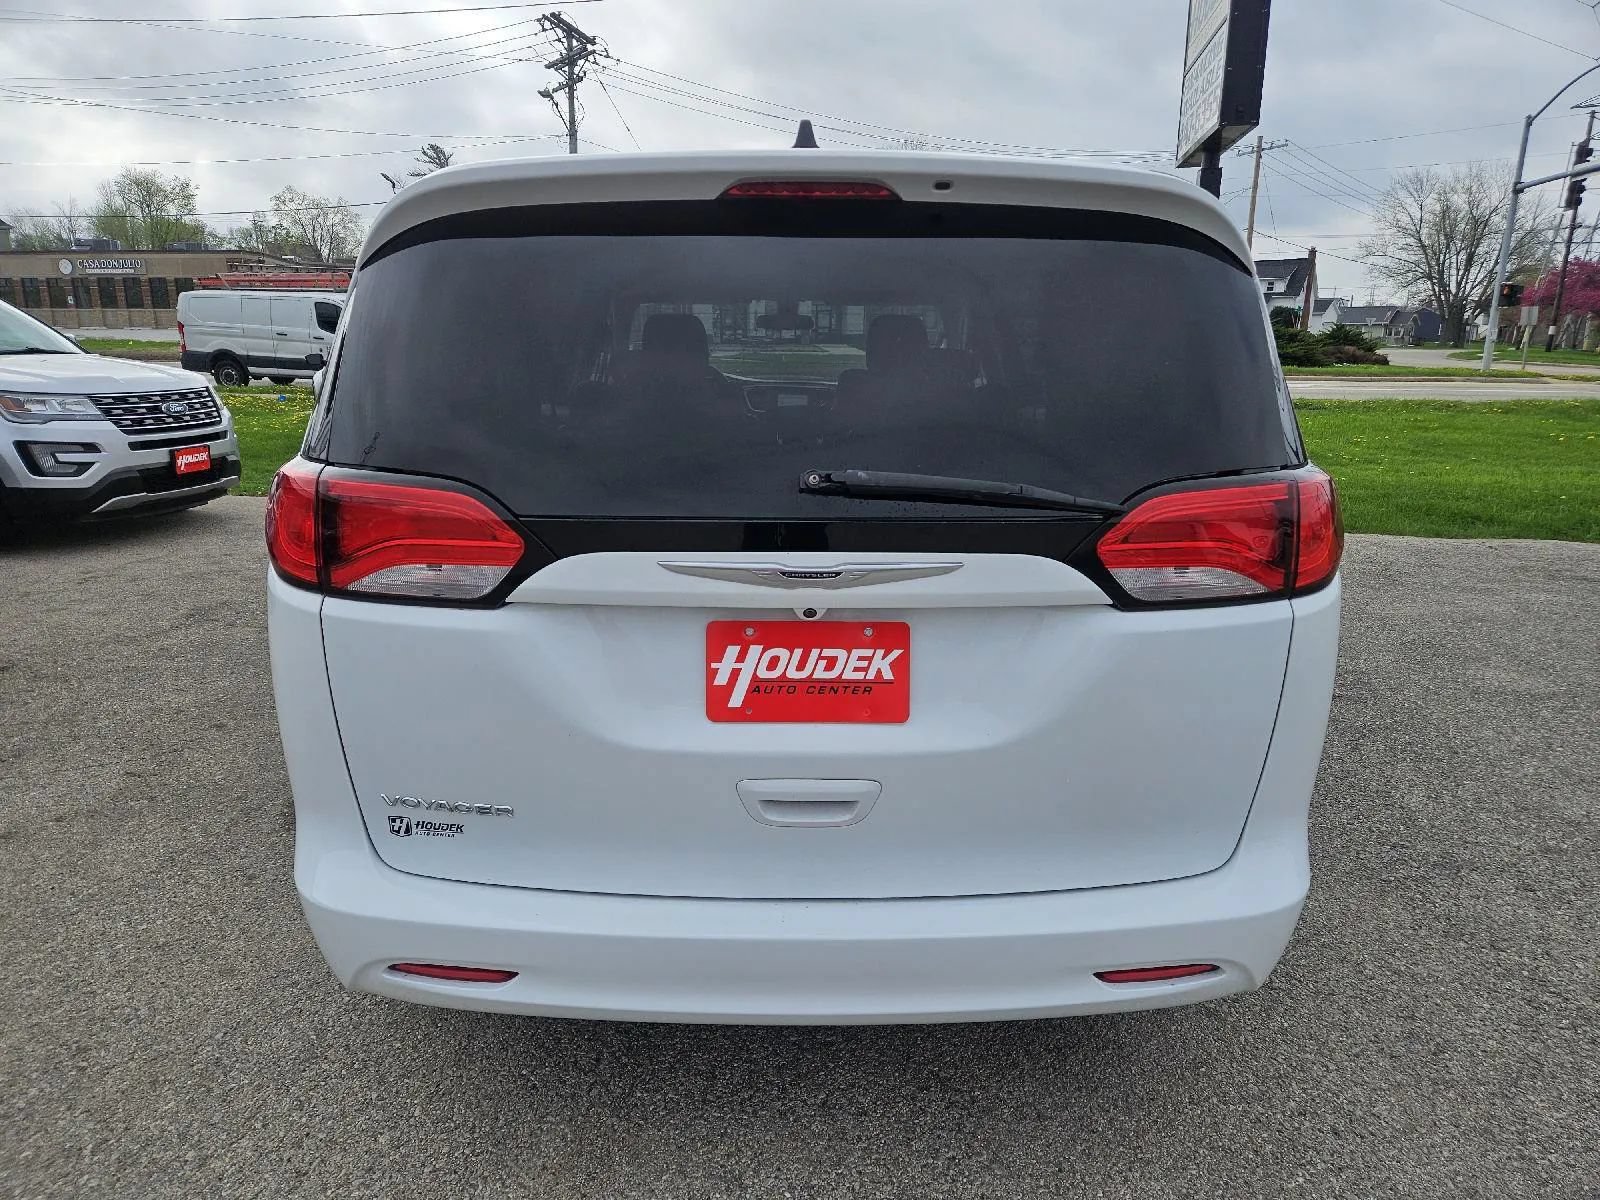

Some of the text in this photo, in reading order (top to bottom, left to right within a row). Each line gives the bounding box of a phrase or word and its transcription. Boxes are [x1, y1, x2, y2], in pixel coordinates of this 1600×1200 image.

[77, 259, 141, 268] CASA DON JULIO
[169, 403, 185, 412] Ford
[177, 451, 209, 471] HOUDEK
[711, 644, 904, 708] HOUDEK
[751, 685, 873, 695] AUTO CENTER
[380, 793, 514, 817] VOYAGER
[414, 820, 465, 832] HOUDEK
